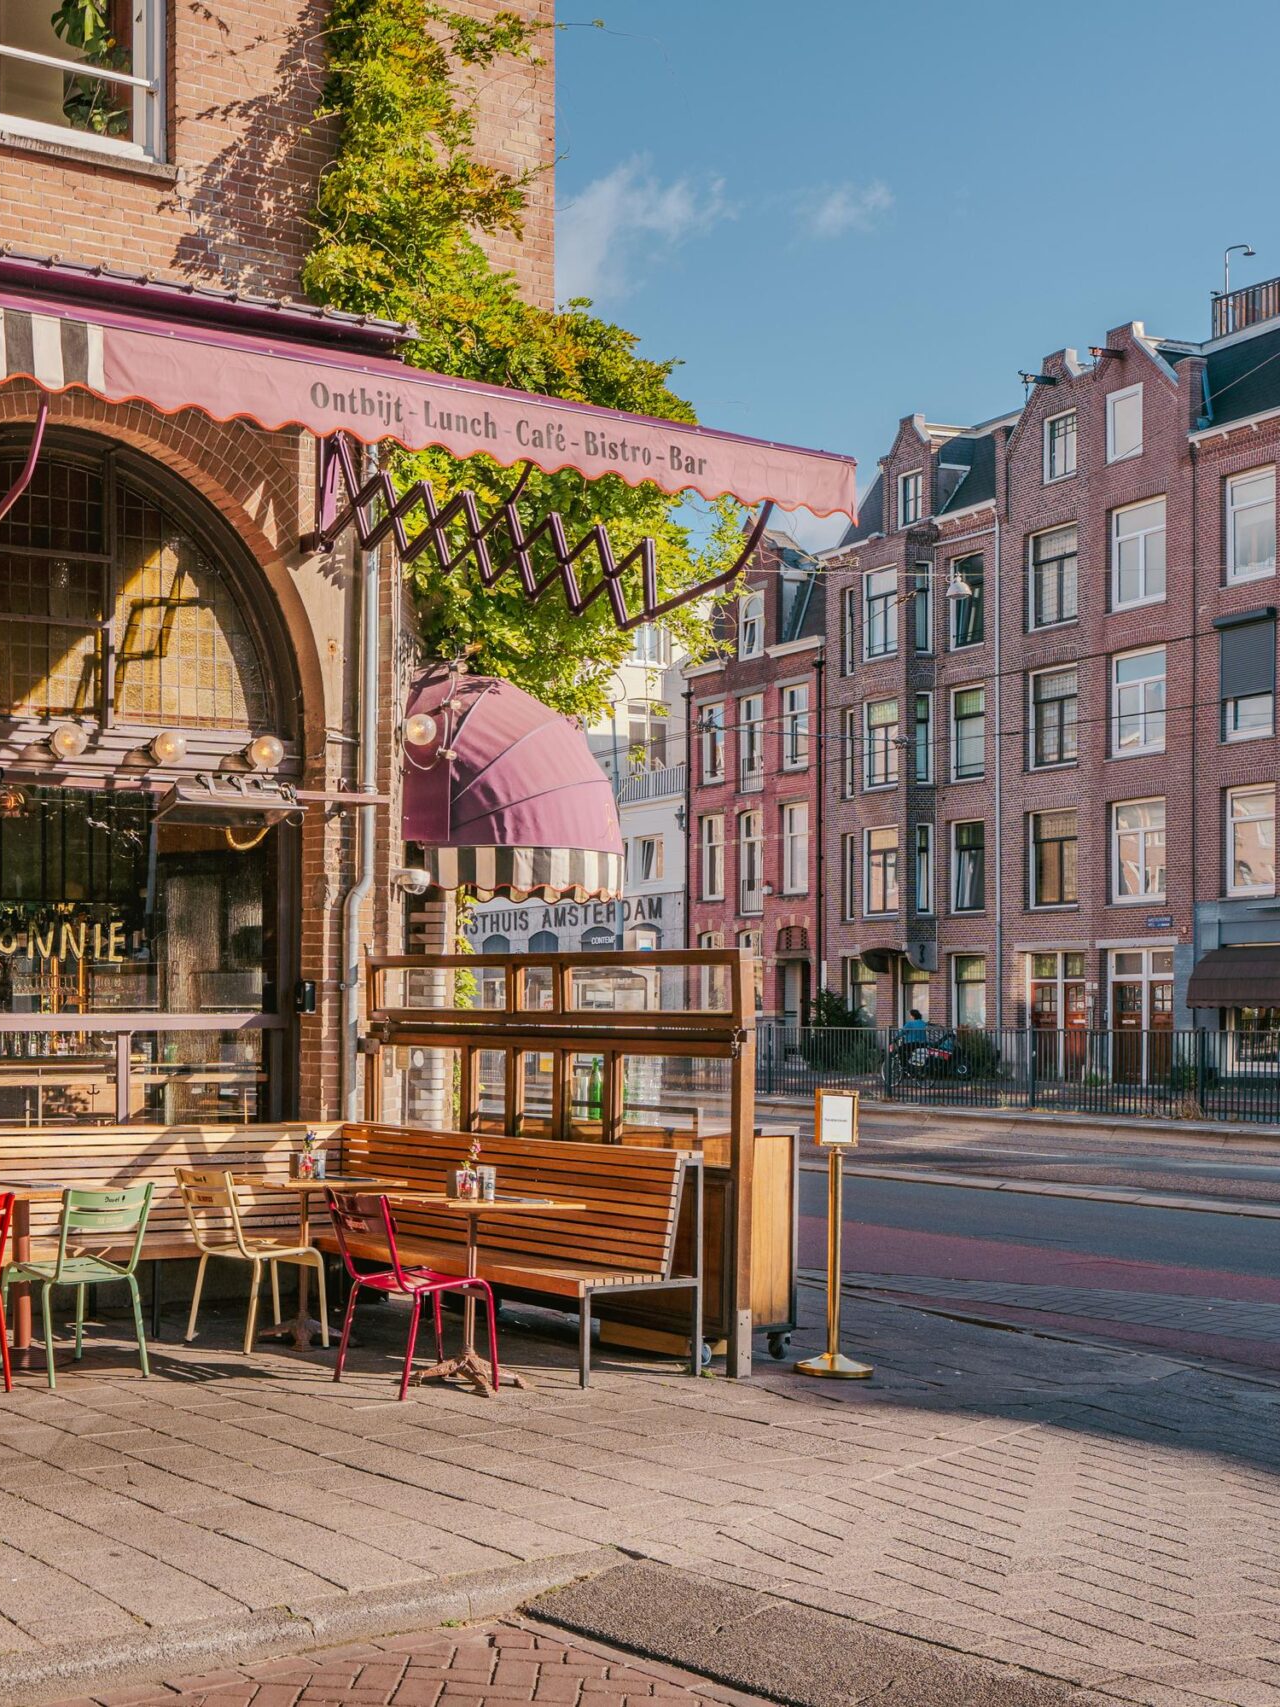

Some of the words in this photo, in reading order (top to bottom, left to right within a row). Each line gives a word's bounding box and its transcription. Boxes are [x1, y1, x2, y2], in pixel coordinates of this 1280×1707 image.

[311, 382, 404, 426] Ontbijt
[424, 400, 498, 439] Lunch
[516, 420, 567, 452] Café
[584, 430, 652, 466] Bistro
[670, 445, 707, 475] Bar
